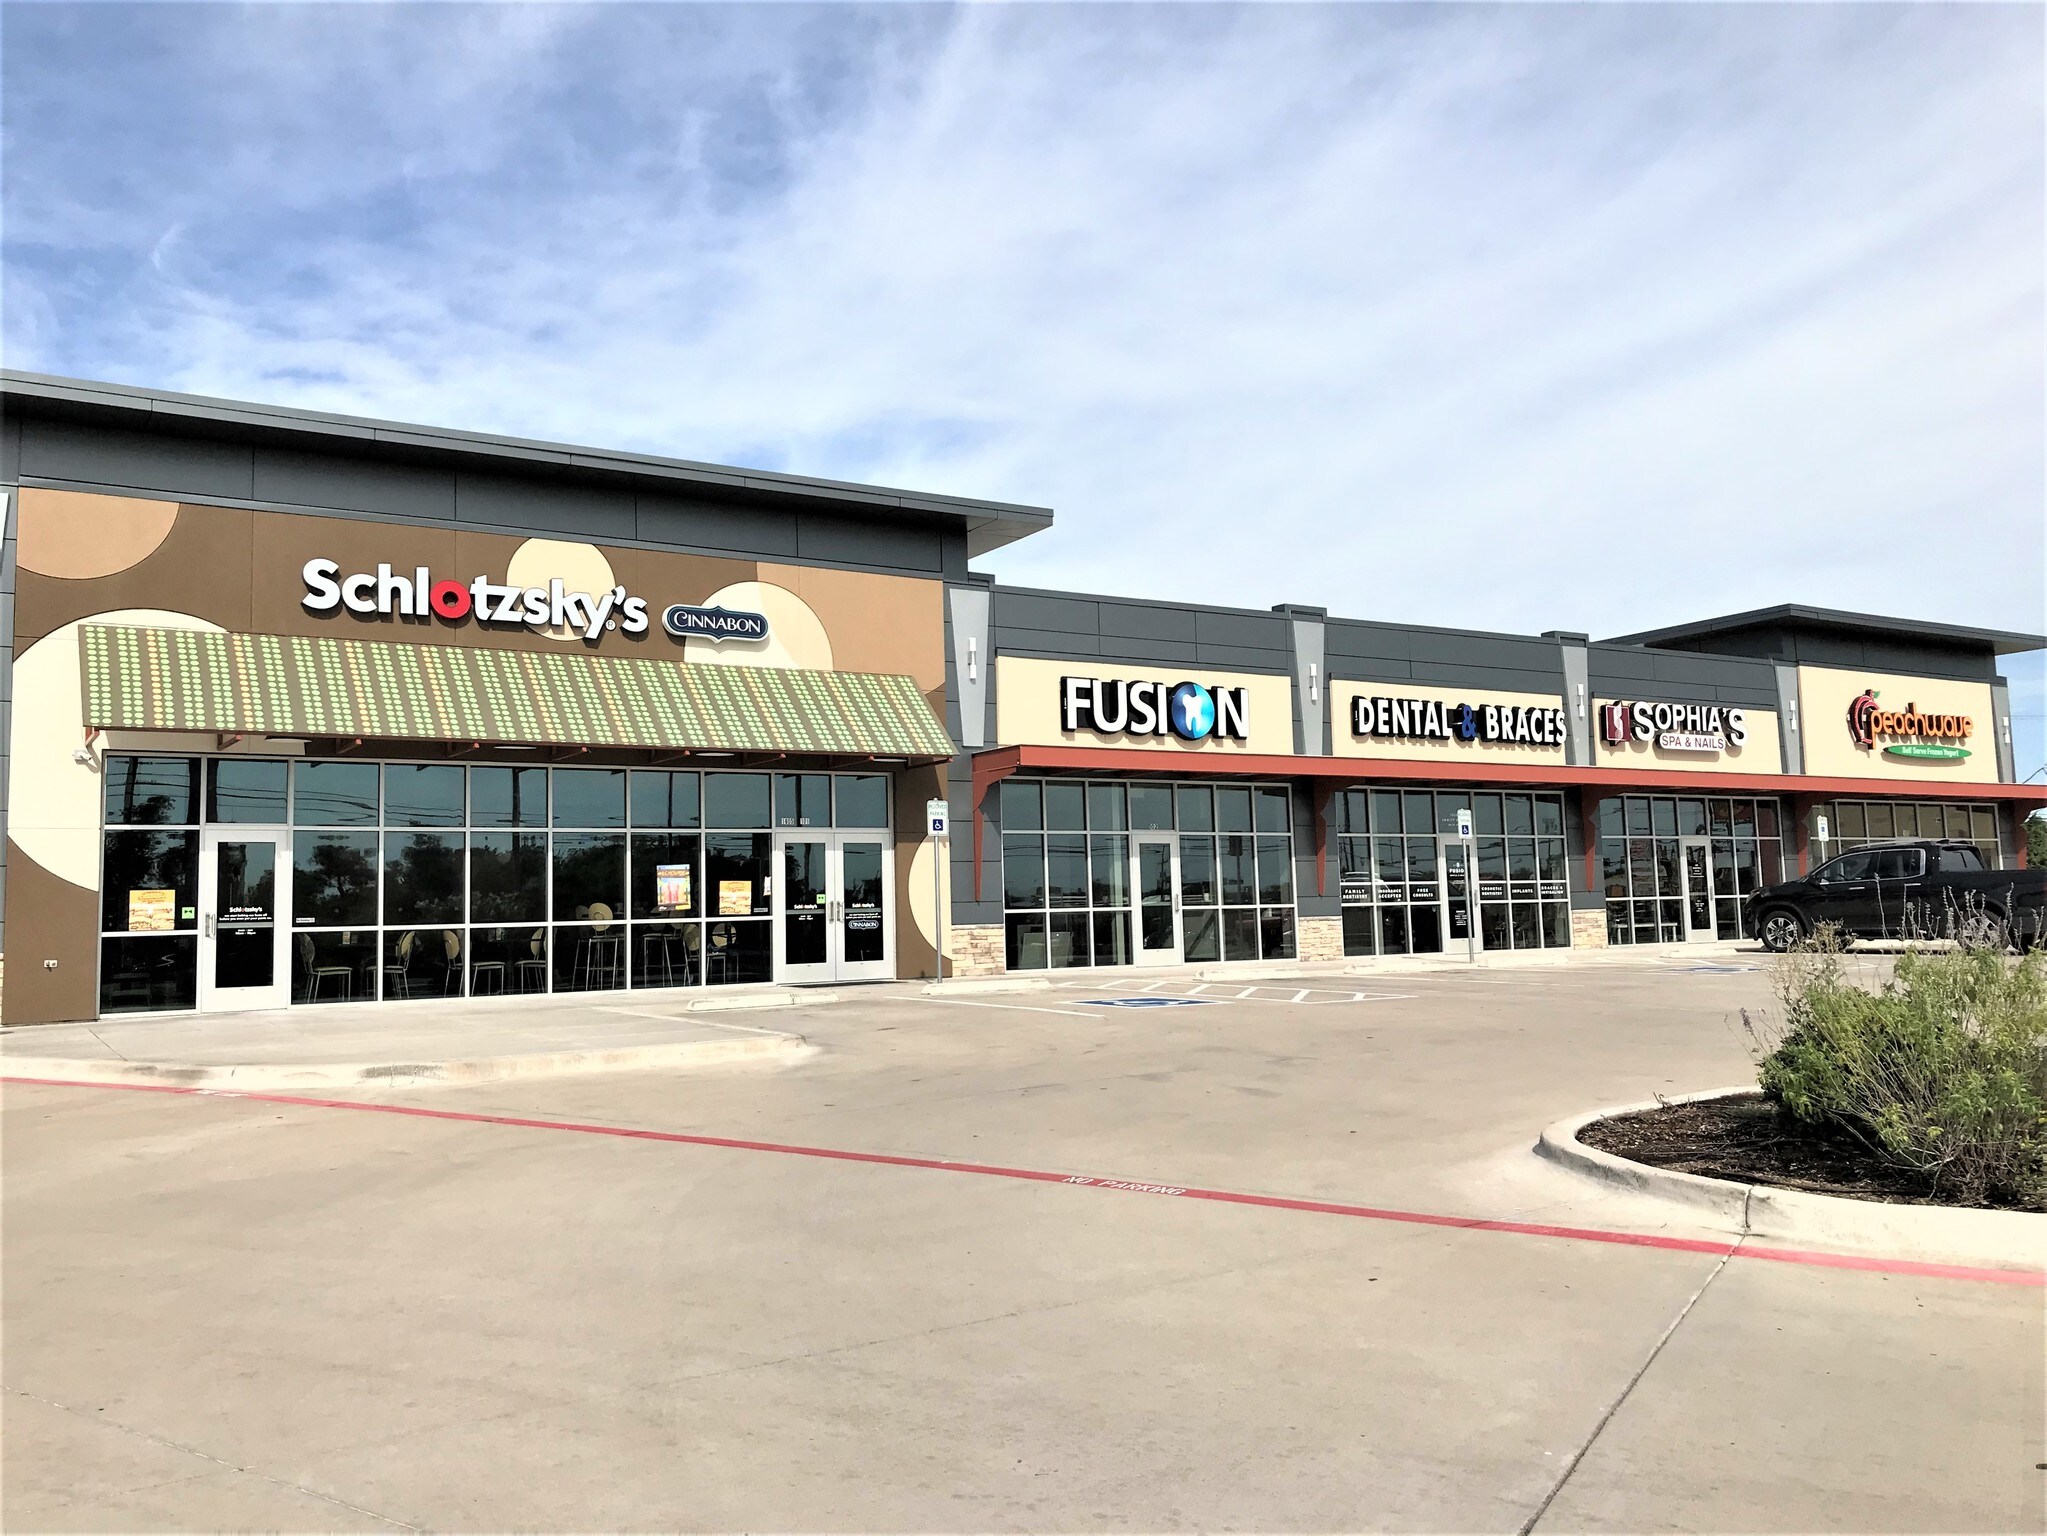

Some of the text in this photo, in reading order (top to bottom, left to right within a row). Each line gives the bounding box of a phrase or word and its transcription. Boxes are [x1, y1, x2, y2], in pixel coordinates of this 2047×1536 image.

[301, 557, 649, 640] Schlotzsky's
[1062, 677, 1250, 740] FUSION
[1354, 696, 1567, 744] DENTAL & BRACES
[1632, 701, 1749, 747] SOPHIA'S
[1869, 702, 1974, 750] peachwave
[1661, 735, 1725, 750] SPA & NAILS
[1061, 1176, 1187, 1196] NO PARKING
